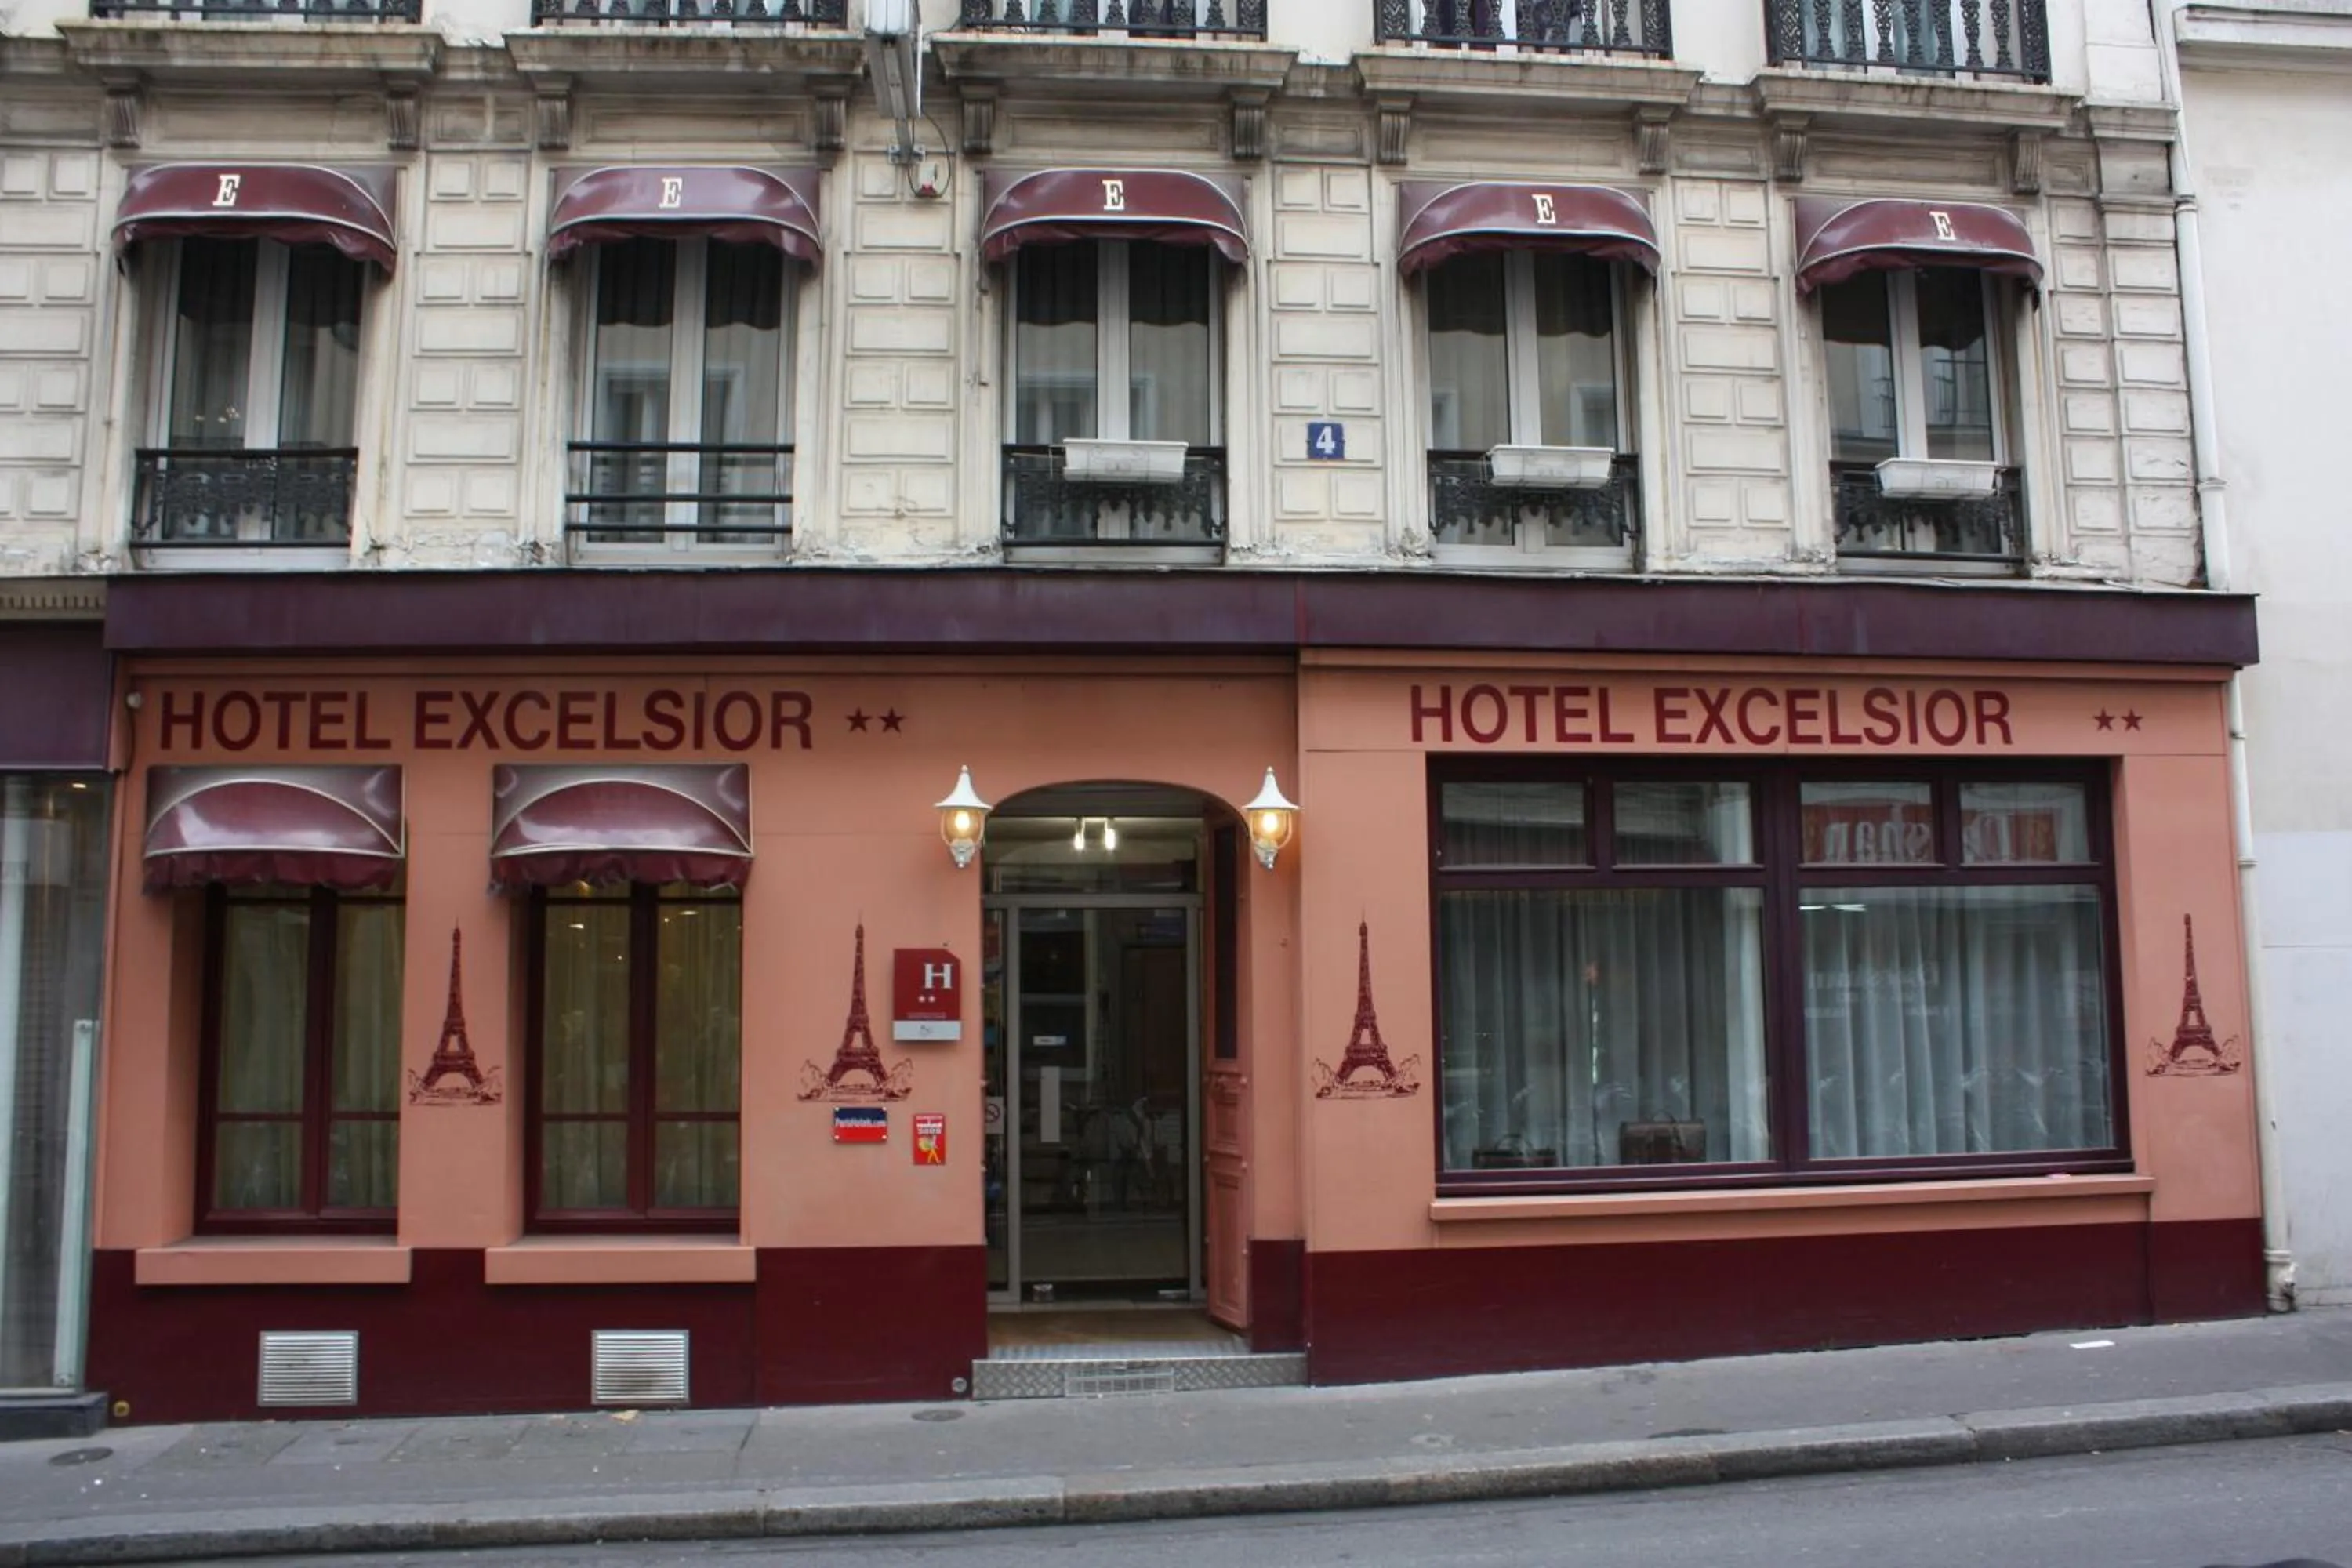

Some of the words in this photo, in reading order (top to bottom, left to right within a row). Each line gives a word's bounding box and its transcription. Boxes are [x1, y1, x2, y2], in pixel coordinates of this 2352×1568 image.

[212, 174, 240, 206] E
[659, 176, 683, 209] E
[1102, 180, 1125, 211] E
[1532, 194, 1555, 223] E
[1929, 211, 1956, 241] E
[1316, 426, 1335, 455] 4
[161, 691, 390, 750] HOTEL
[414, 690, 813, 751] EXCELSIOR
[1411, 684, 1635, 743] HOTEL
[1654, 687, 2013, 746] EXCELSIOR
[924, 963, 952, 989] H
